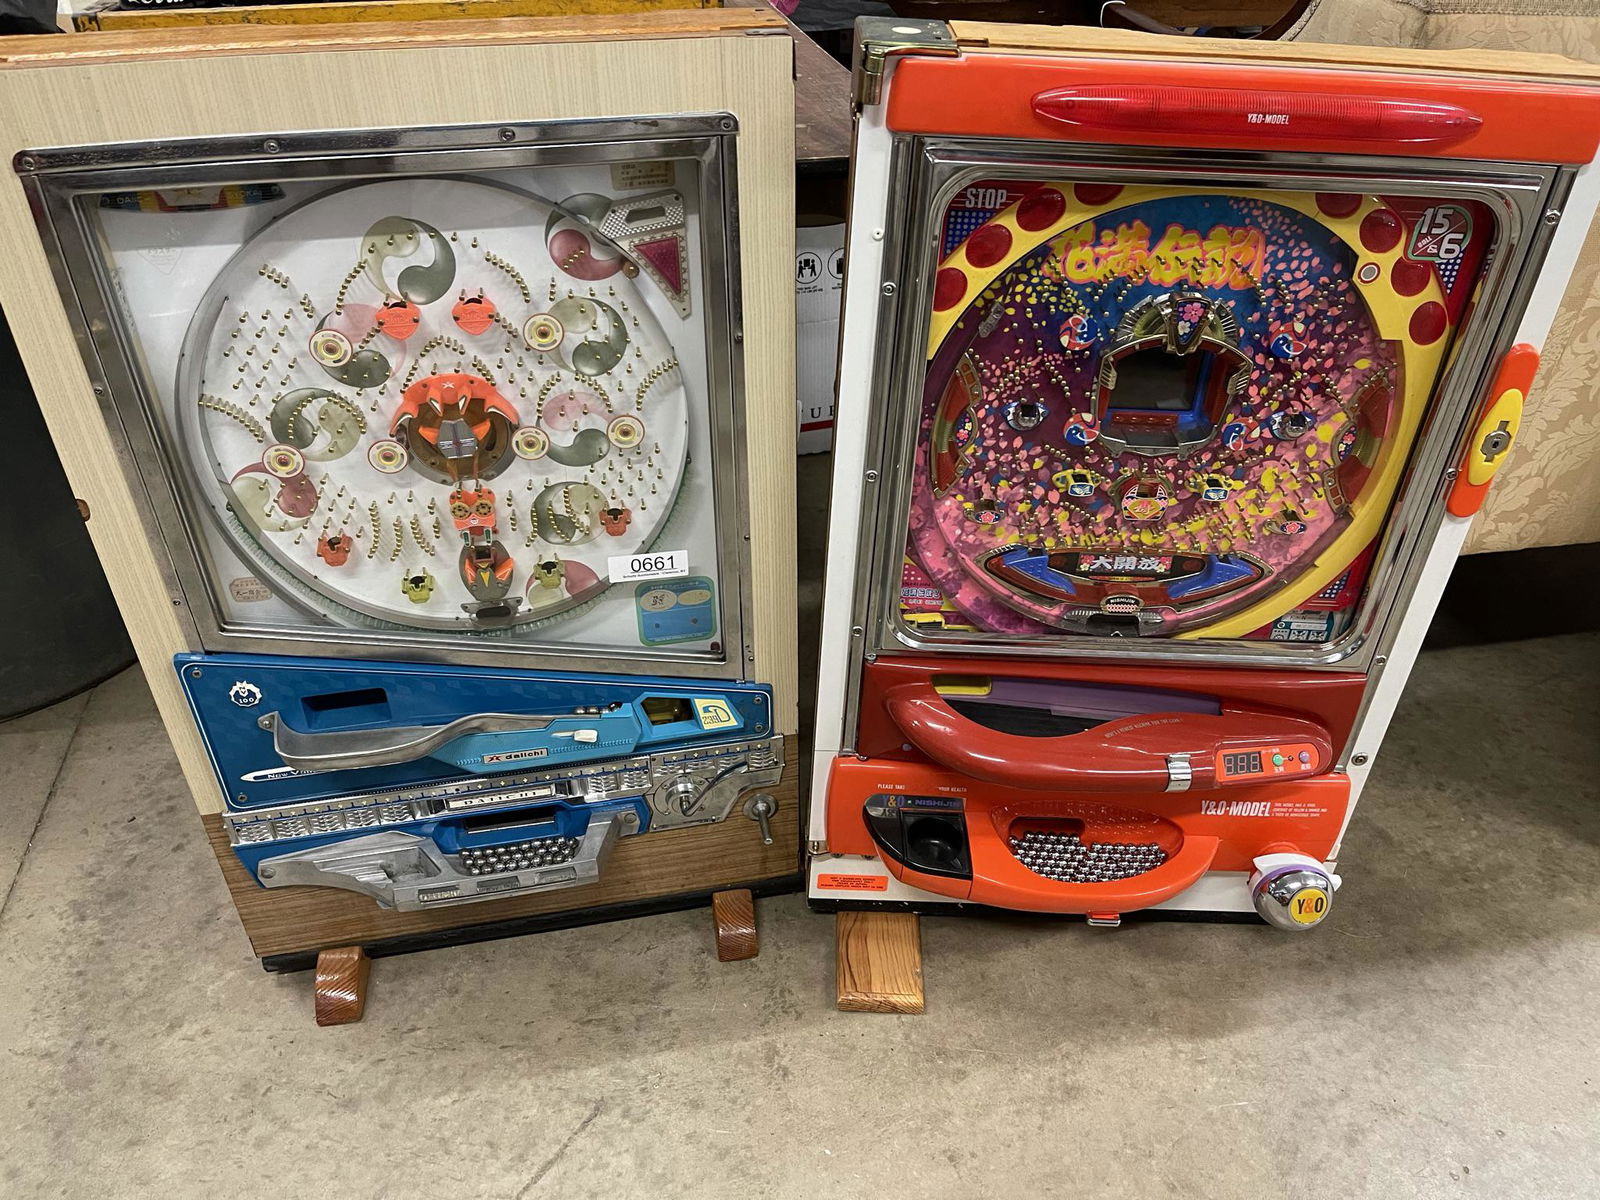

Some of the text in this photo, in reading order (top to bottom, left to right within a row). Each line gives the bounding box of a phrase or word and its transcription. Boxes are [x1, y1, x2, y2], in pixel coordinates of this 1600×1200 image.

[965, 188, 1007, 209] STOP
[1420, 207, 1454, 234] 15
[1438, 233, 1464, 259] 6
[630, 555, 674, 573] 0661
[1090, 556, 1163, 571] 大開放
[505, 750, 543, 760] daiichi
[882, 795, 905, 808] Y&O
[1297, 897, 1324, 914] Y&O
